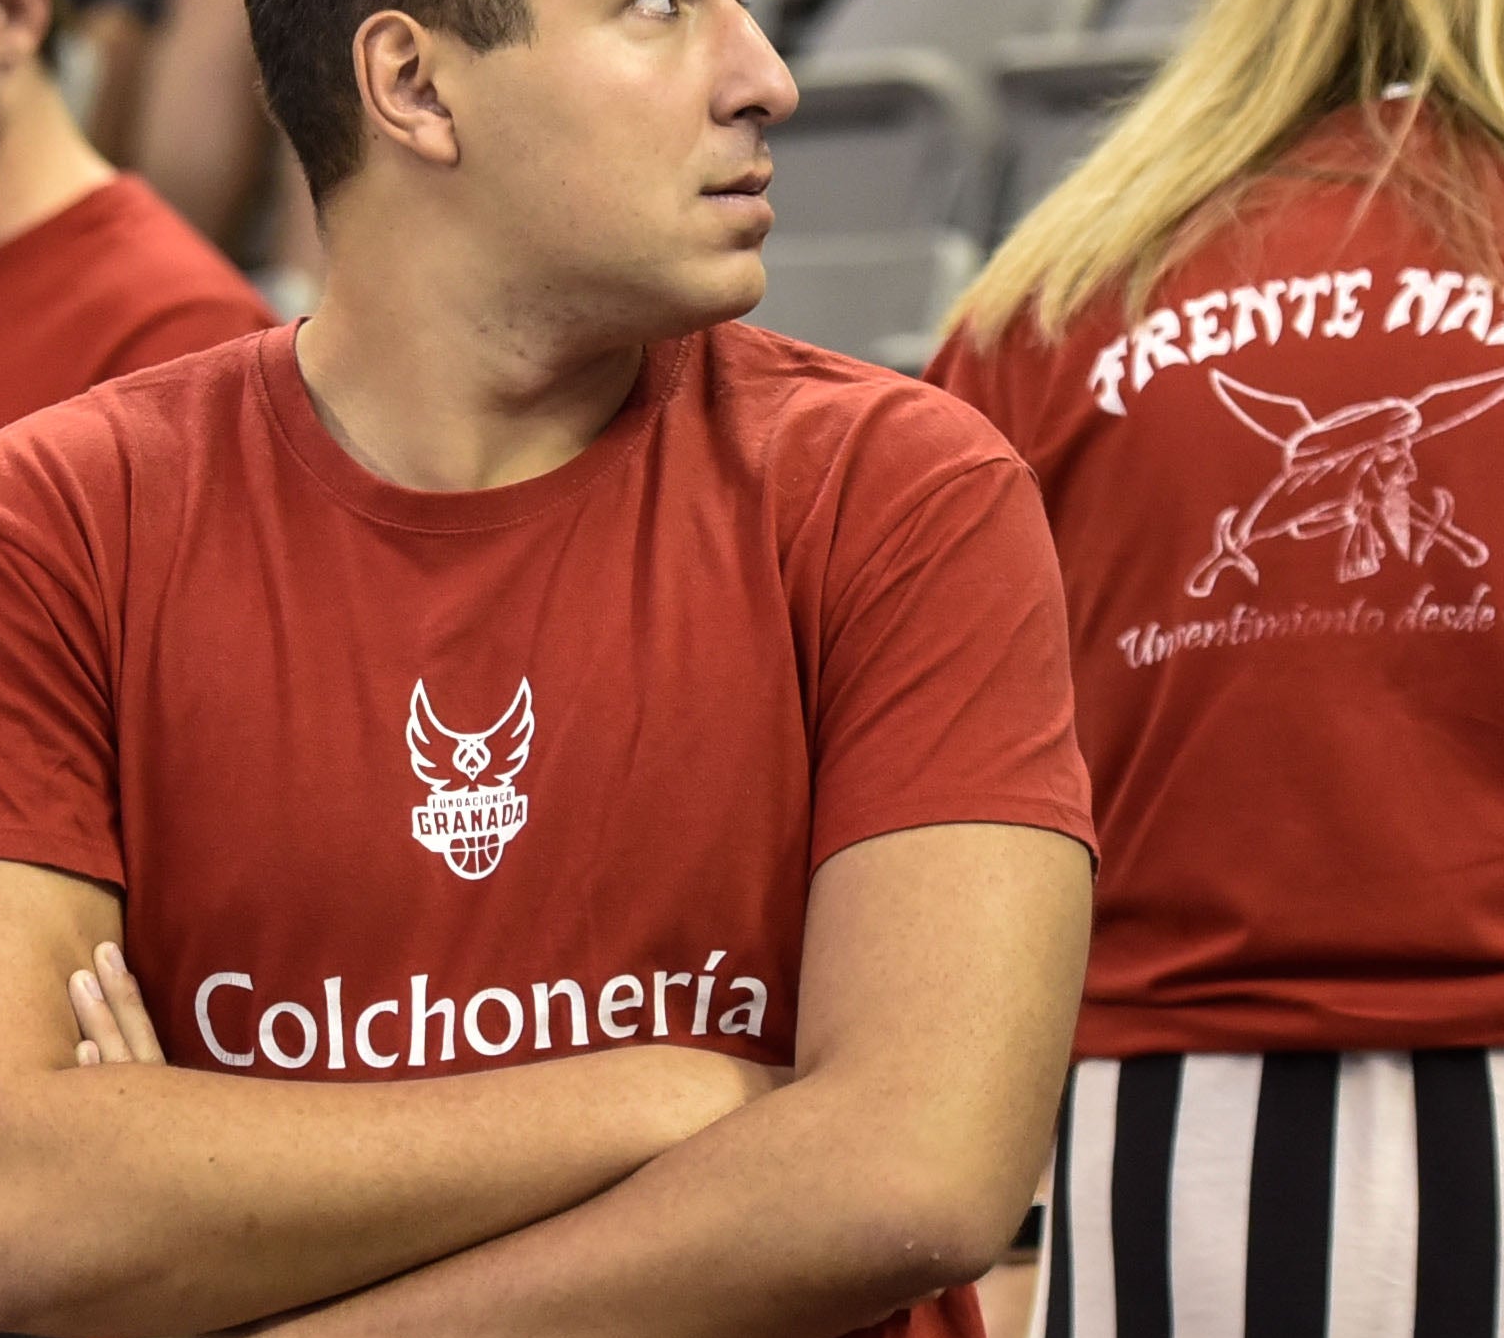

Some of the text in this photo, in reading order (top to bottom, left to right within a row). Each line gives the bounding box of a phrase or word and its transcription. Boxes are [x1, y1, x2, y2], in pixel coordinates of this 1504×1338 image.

[1086, 268, 1373, 417] FRENTE
[1394, 583, 1496, 635] desde
[417, 801, 523, 835] GRANADA
[194, 949, 768, 1070] Colchonería
